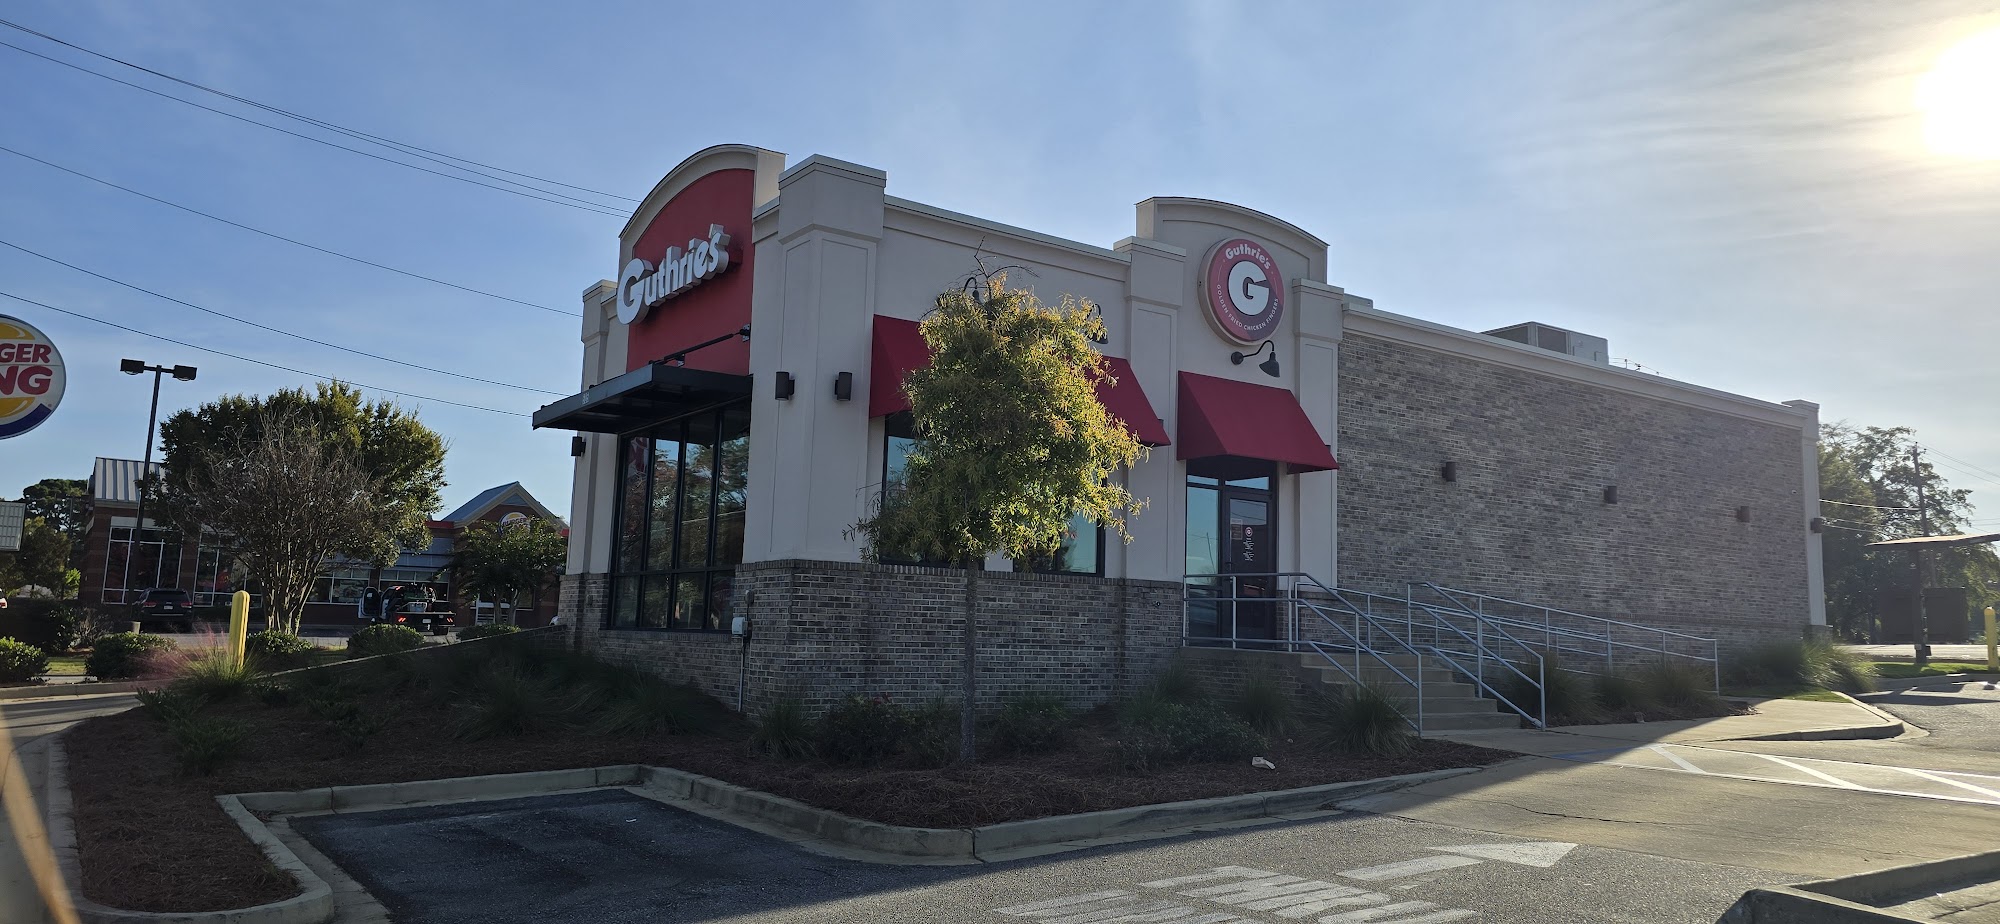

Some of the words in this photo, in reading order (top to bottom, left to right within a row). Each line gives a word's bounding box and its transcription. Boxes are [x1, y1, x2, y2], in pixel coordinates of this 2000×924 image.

[617, 223, 730, 325] Guthrie's
[1225, 244, 1271, 270] Guthrie's
[1216, 284, 1229, 314] GOLDEN
[1228, 313, 1243, 328] FRIED
[1243, 322, 1266, 331] CHICKEN
[1266, 298, 1279, 324] FINGERS
[1228, 260, 1270, 316] G
